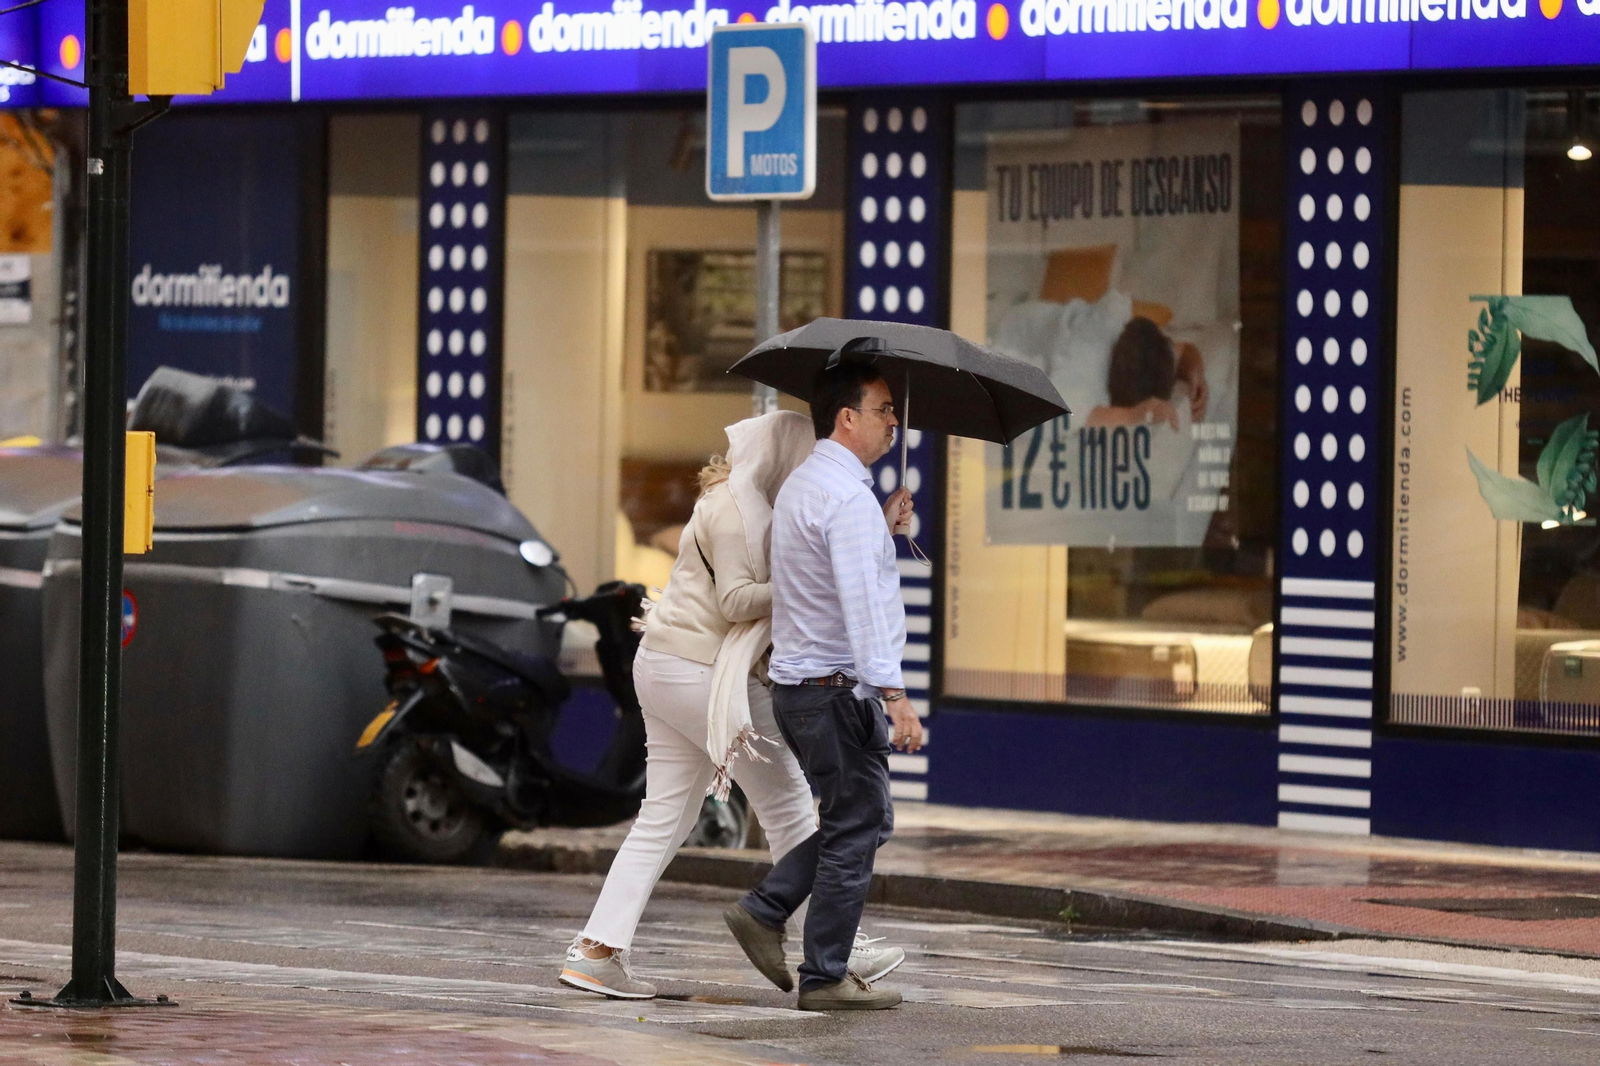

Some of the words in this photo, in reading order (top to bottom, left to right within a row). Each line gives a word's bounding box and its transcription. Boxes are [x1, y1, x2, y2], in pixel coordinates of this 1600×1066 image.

[305, 5, 495, 60] dormitienda
[727, 47, 786, 178] P
[751, 154, 798, 176] MOTOS
[996, 164, 1022, 222] TU
[1028, 161, 1093, 228] EQUIPO
[1101, 159, 1123, 218] DE
[1131, 152, 1231, 217] DESCANSO
[131, 263, 289, 307] dormitienda
[1002, 413, 1070, 510] 12€
[1079, 425, 1151, 510] mes
[1396, 386, 1411, 663] www.dormitienda.com
